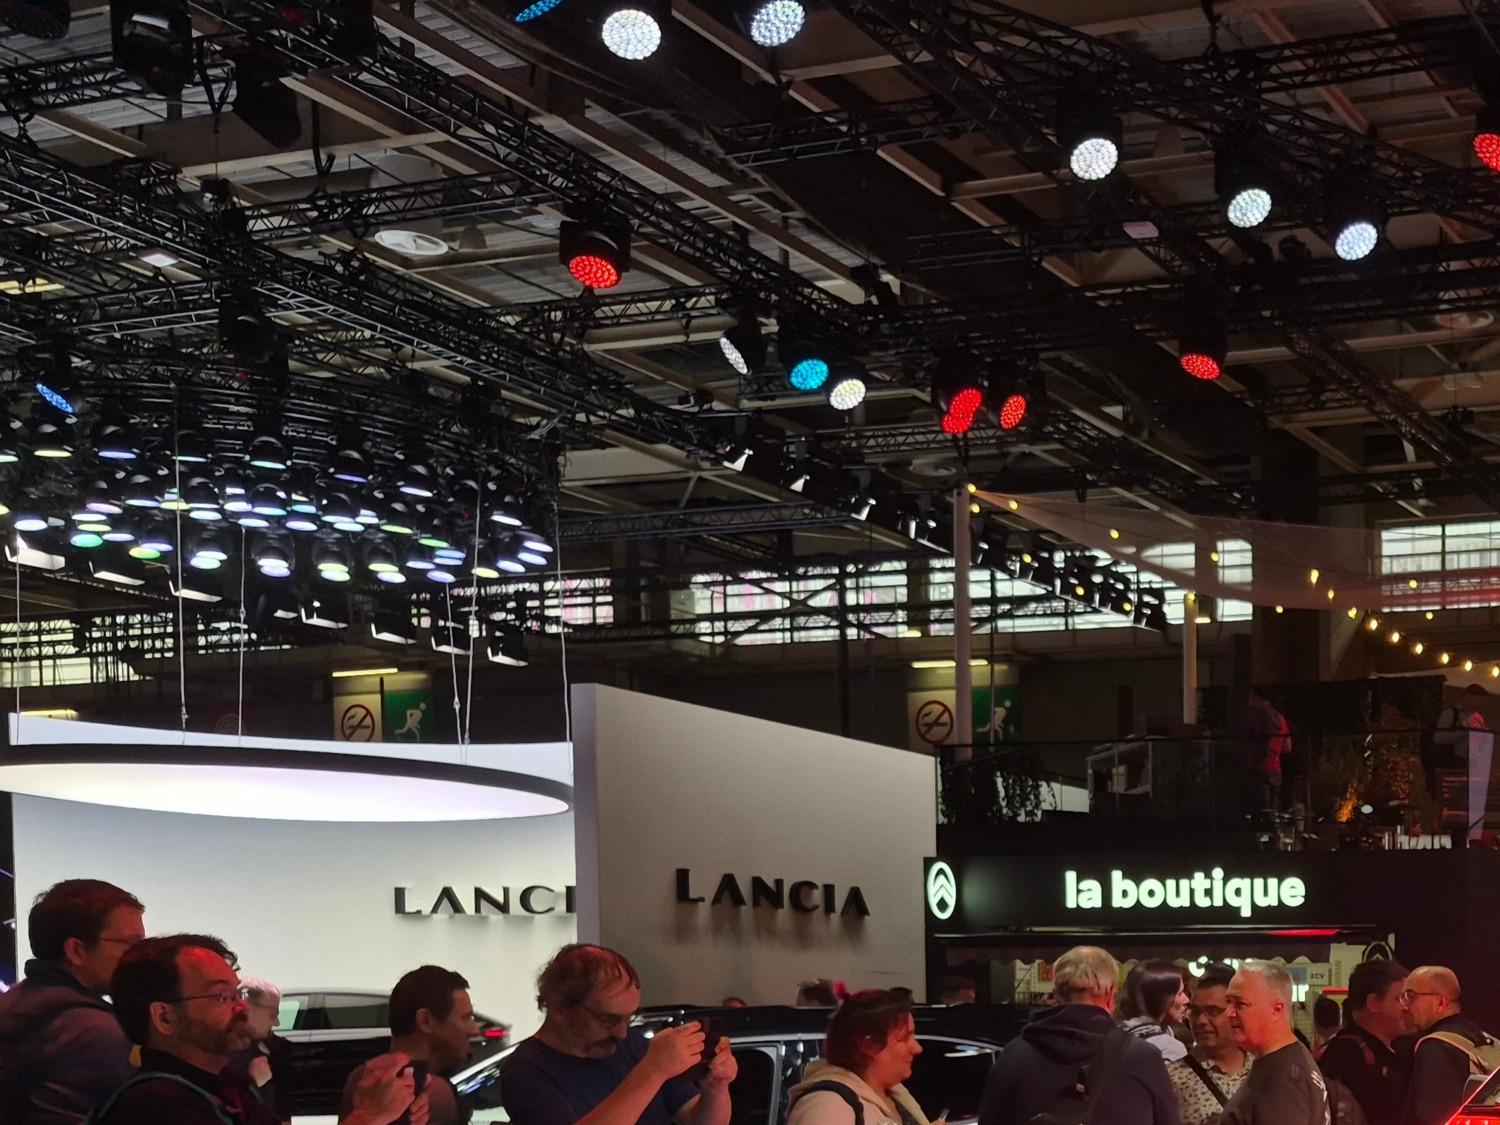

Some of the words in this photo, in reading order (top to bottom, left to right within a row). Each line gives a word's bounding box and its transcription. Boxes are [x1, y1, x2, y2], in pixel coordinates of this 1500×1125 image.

[675, 868, 871, 917] LANCIA
[1065, 870, 1102, 908] la
[1111, 867, 1306, 917] boutique
